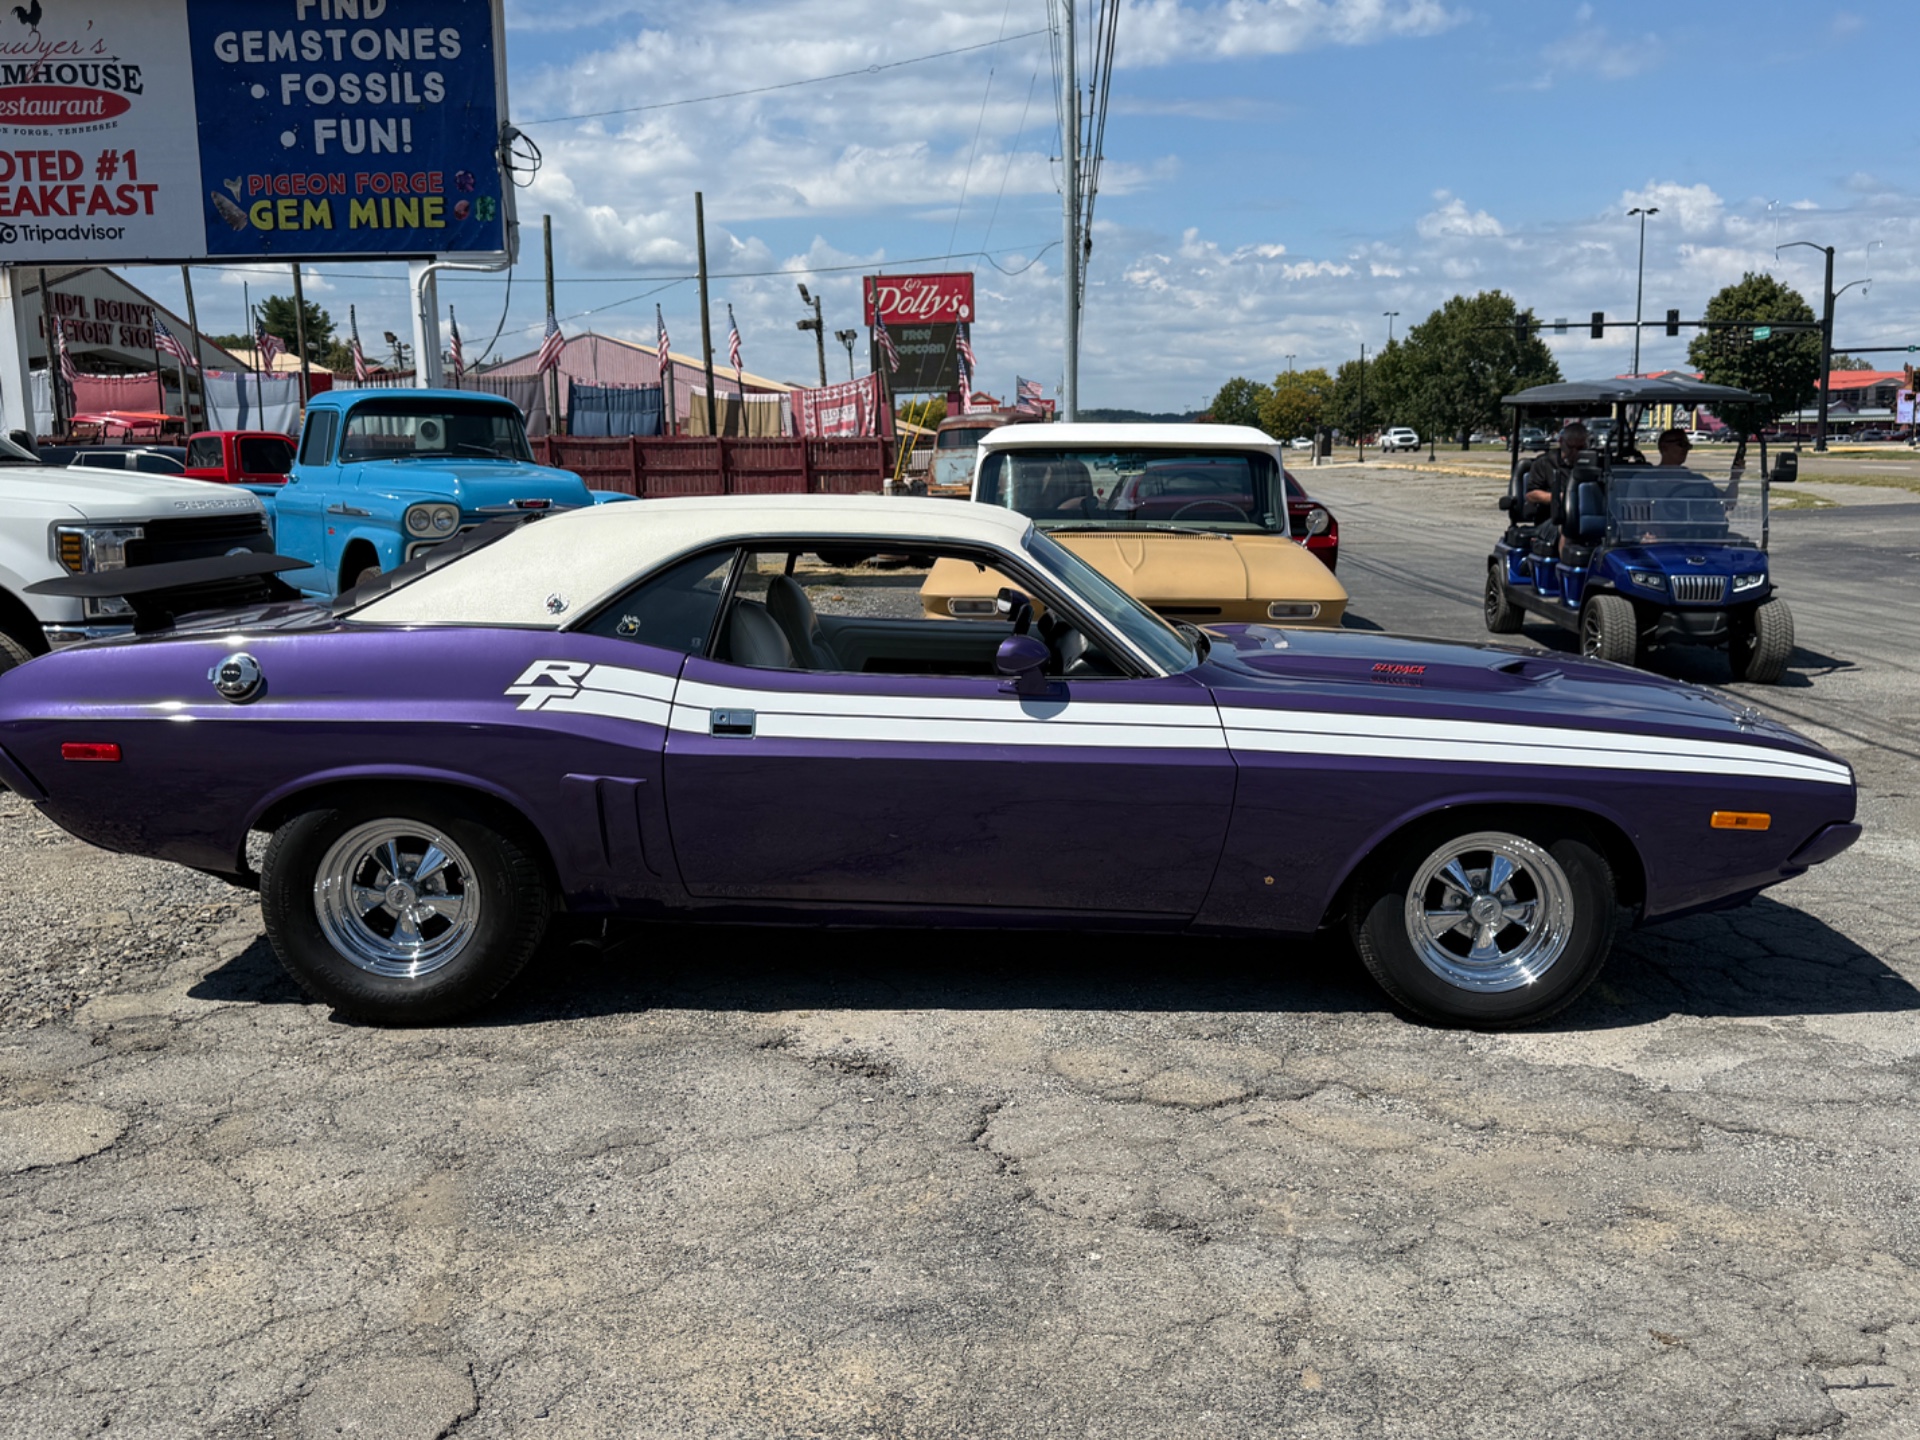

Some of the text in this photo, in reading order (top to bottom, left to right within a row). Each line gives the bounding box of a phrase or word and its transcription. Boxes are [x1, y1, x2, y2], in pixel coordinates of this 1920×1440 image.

[296, 0, 387, 21] FIND
[214, 28, 462, 63] GEMSTONES
[0, 63, 144, 95] MHOUSE
[280, 71, 446, 105] FOSSILS
[58, 120, 118, 135] TENNESSEE
[313, 118, 413, 155] FUN!
[96, 149, 137, 181] #1
[248, 171, 445, 195] PIGEON FORGE
[249, 196, 446, 231] GEM MINE
[19, 224, 125, 244] Tripadvisor
[94, 298, 155, 327] DOLLY'S
[868, 284, 963, 319] Dolly's
